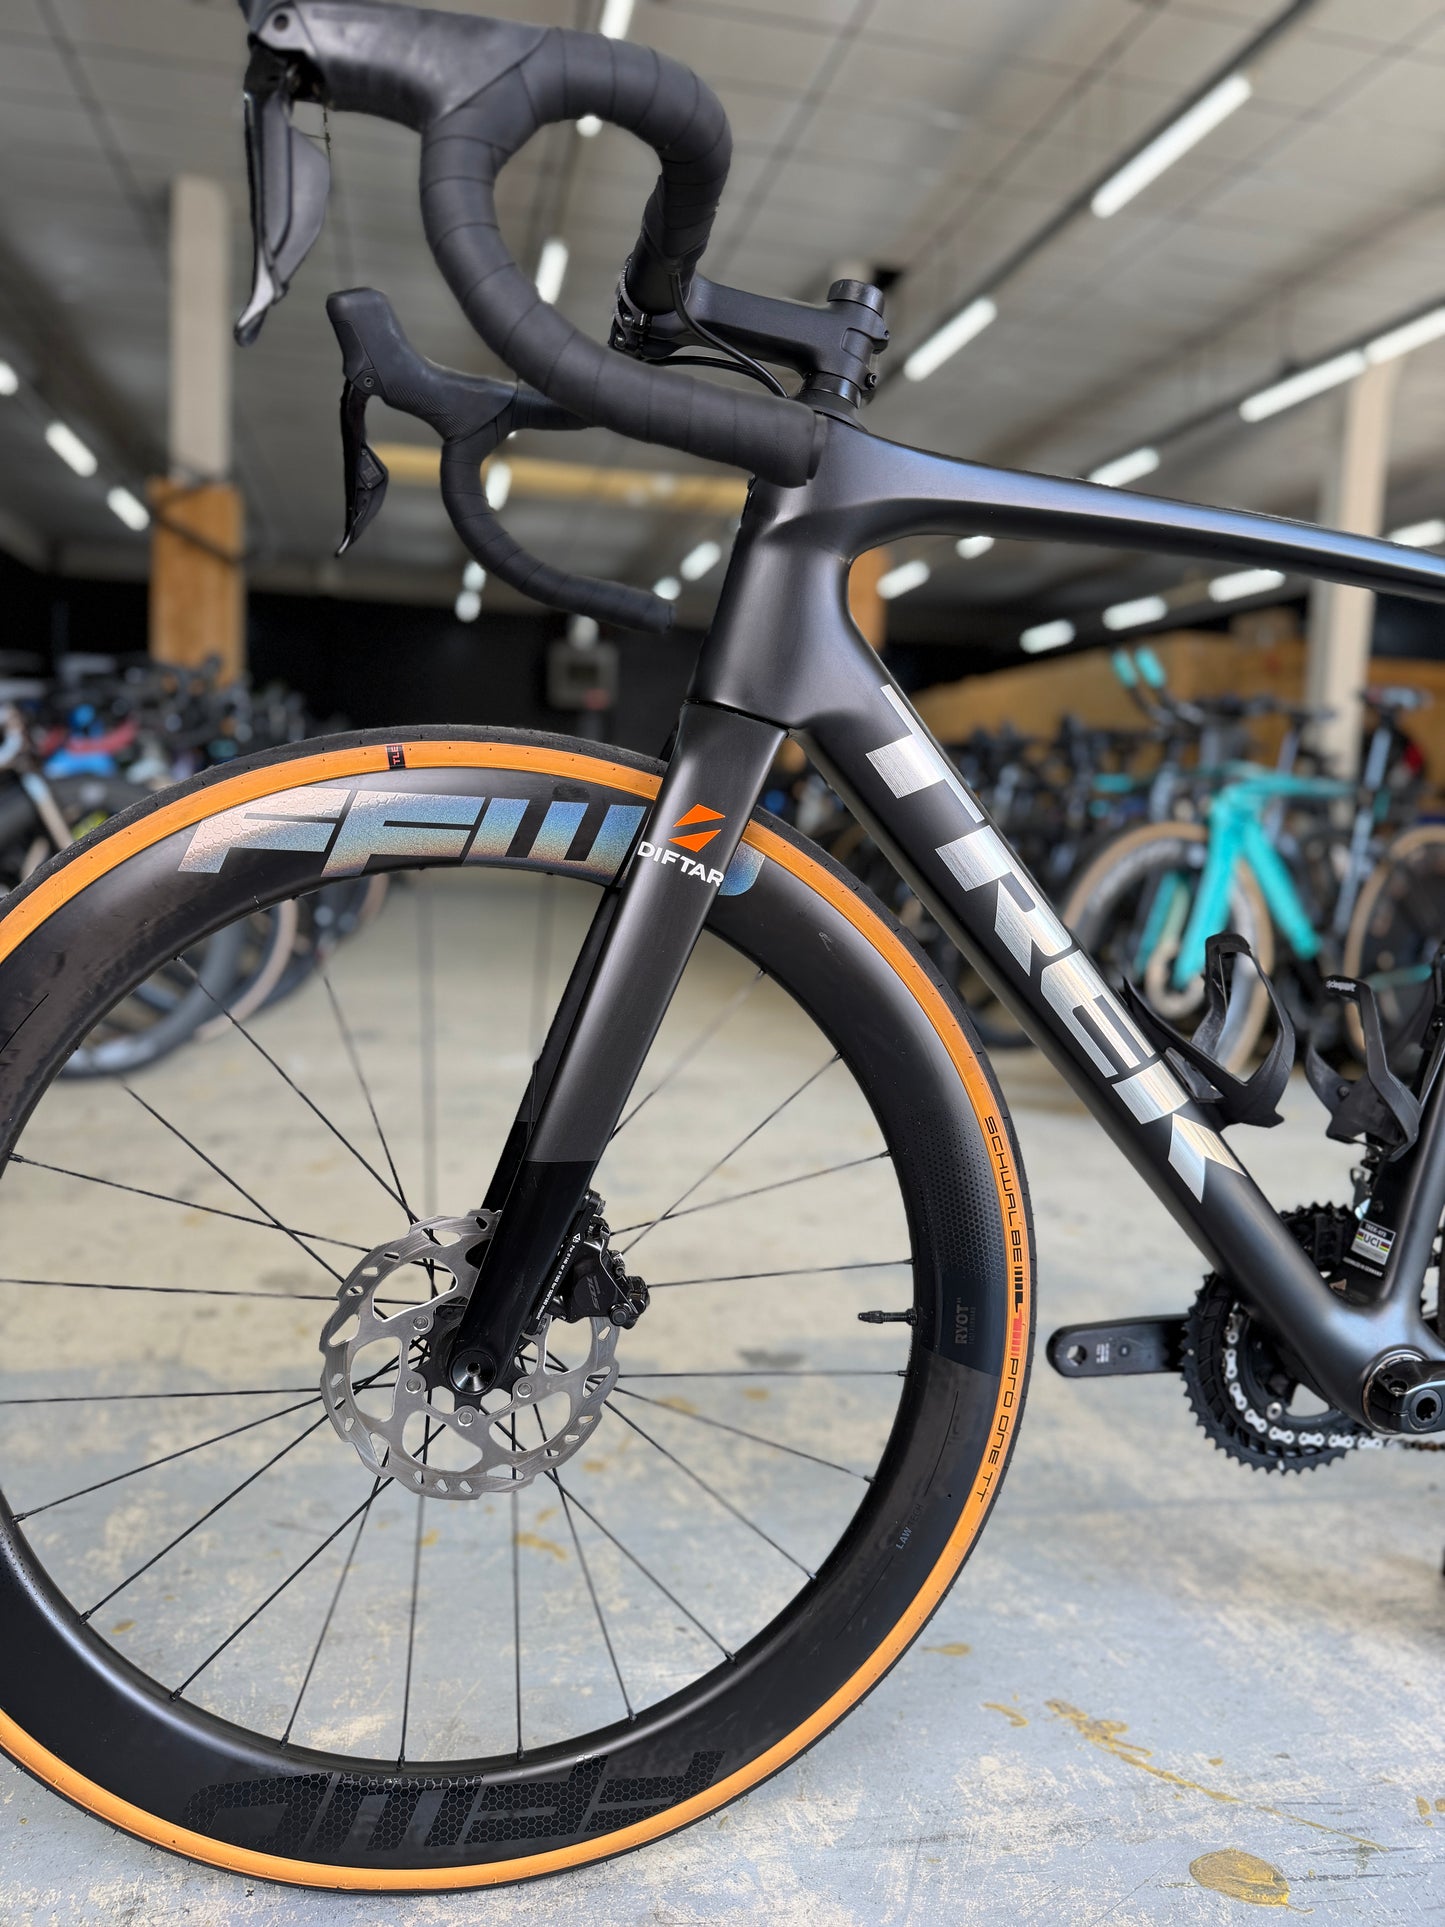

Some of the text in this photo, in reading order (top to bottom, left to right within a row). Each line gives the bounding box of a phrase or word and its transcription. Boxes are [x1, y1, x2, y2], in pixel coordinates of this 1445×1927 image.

[391, 746, 401, 765] TLE
[637, 841, 725, 887] DIFTAR
[865, 684, 1246, 1203] TREK
[985, 1116, 1022, 1262] SCHWALBE
[1363, 1233, 1381, 1248] UCI
[954, 1304, 969, 1345] RYOT
[976, 1471, 993, 1503] TT
[895, 1526, 912, 1550] LAW
